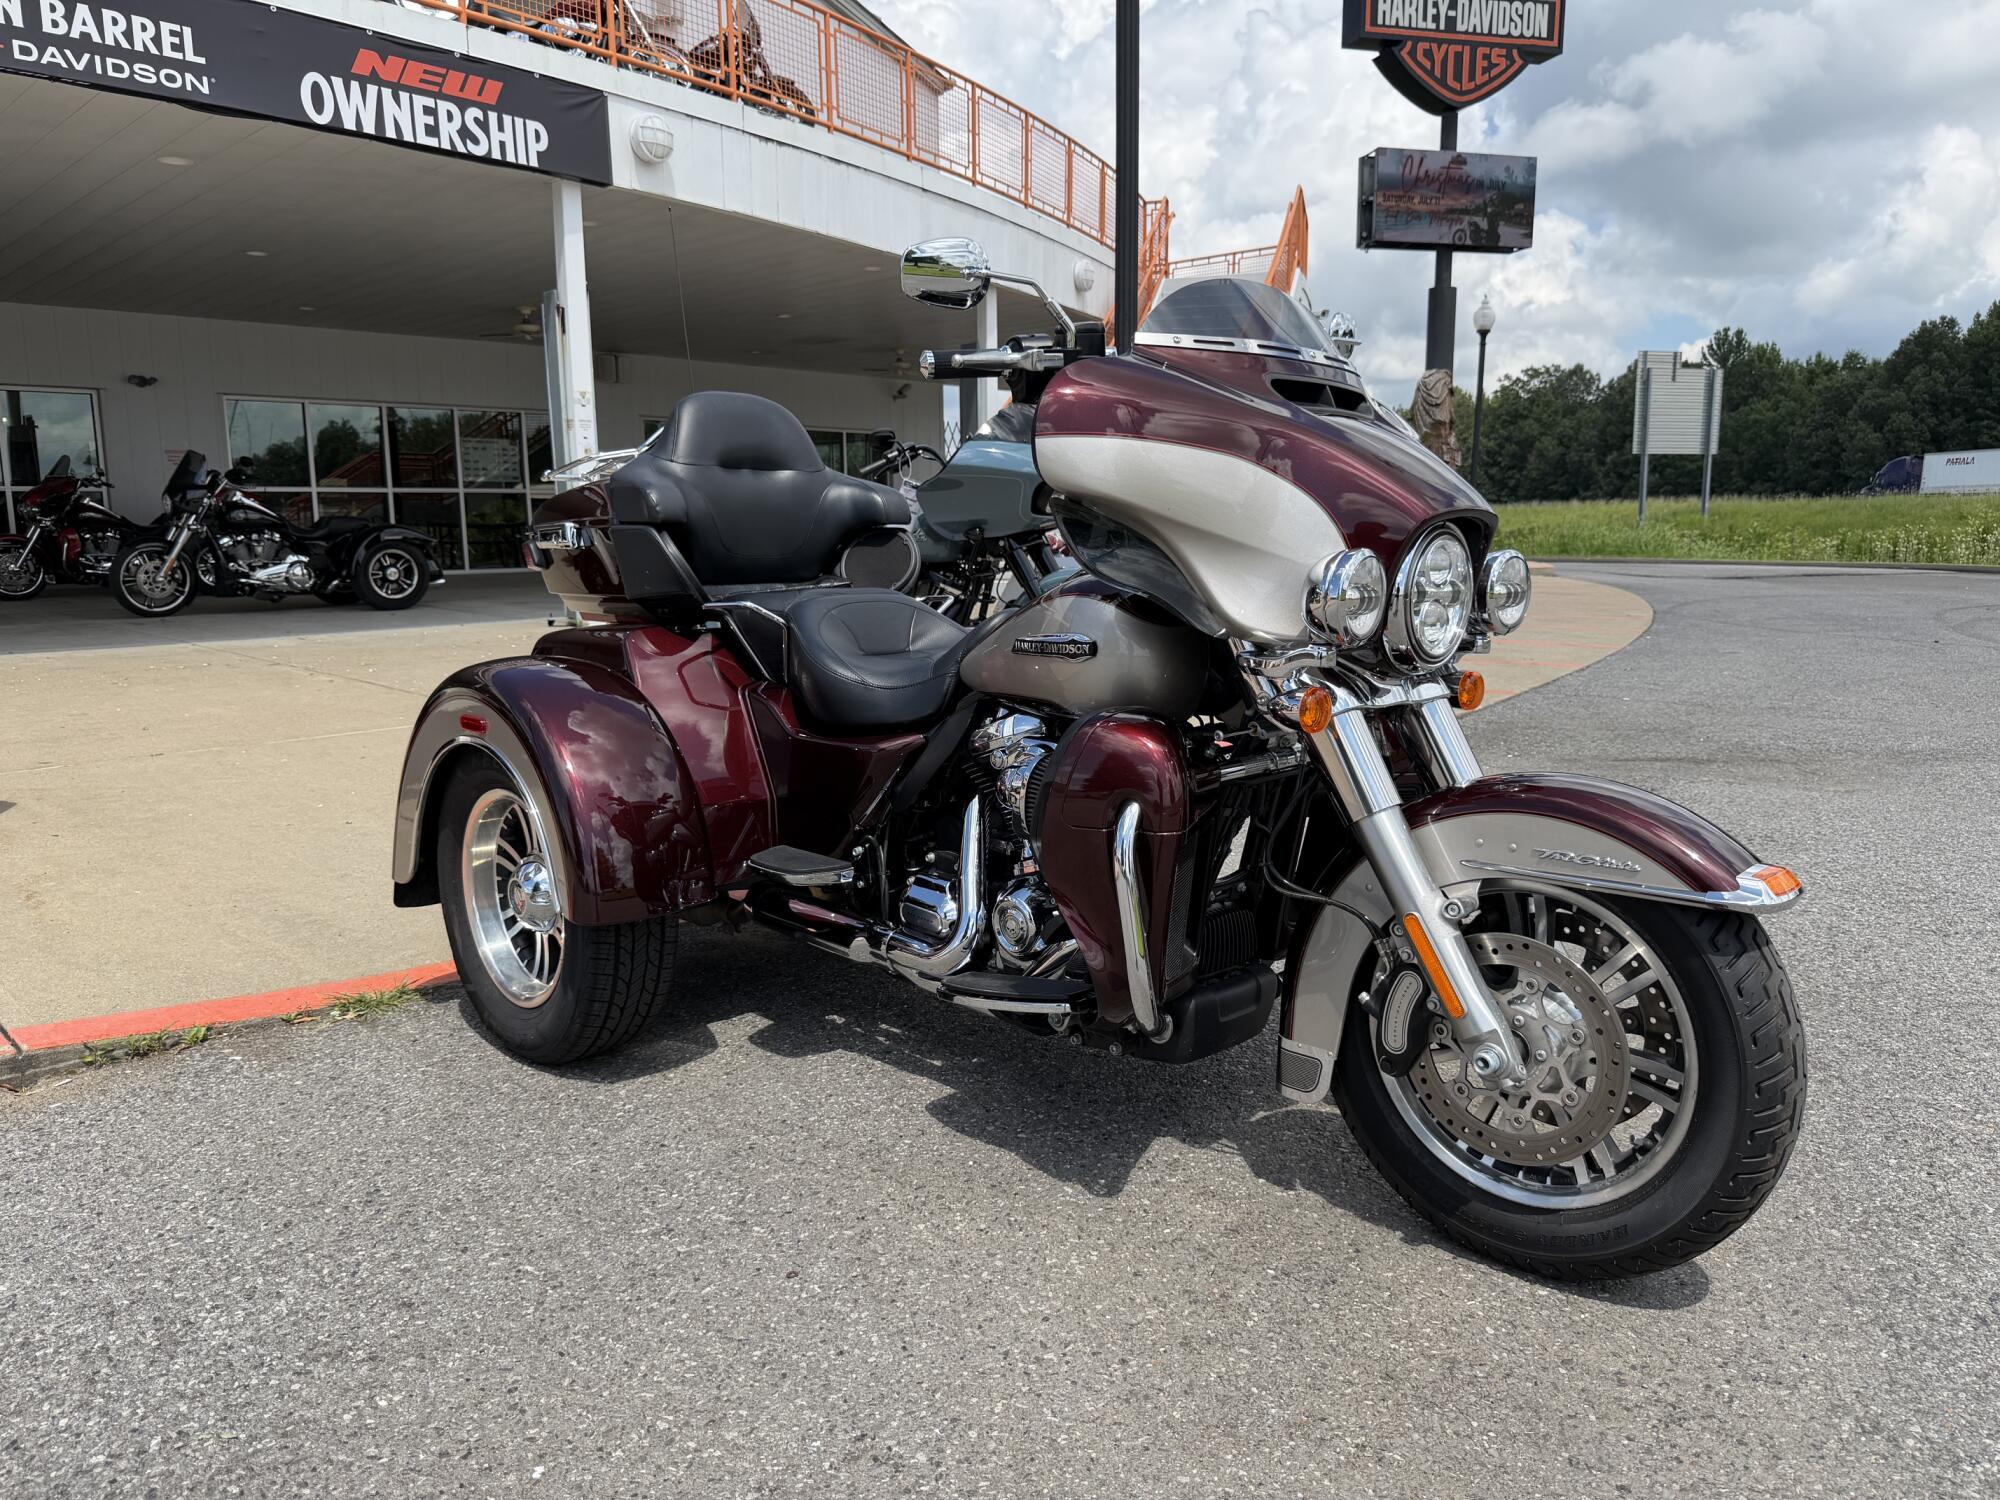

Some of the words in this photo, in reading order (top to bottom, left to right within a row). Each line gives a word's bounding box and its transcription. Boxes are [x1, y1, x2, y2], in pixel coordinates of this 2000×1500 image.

[40, 0, 206, 64] BARREL
[1377, 0, 1548, 38] HARLEY-DAVIDSON
[351, 48, 503, 105] NEW
[1416, 41, 1508, 91] CYCLES
[300, 71, 549, 168] OWNERSHIP
[1014, 640, 1090, 654] HARLEY-DAVIDSON
